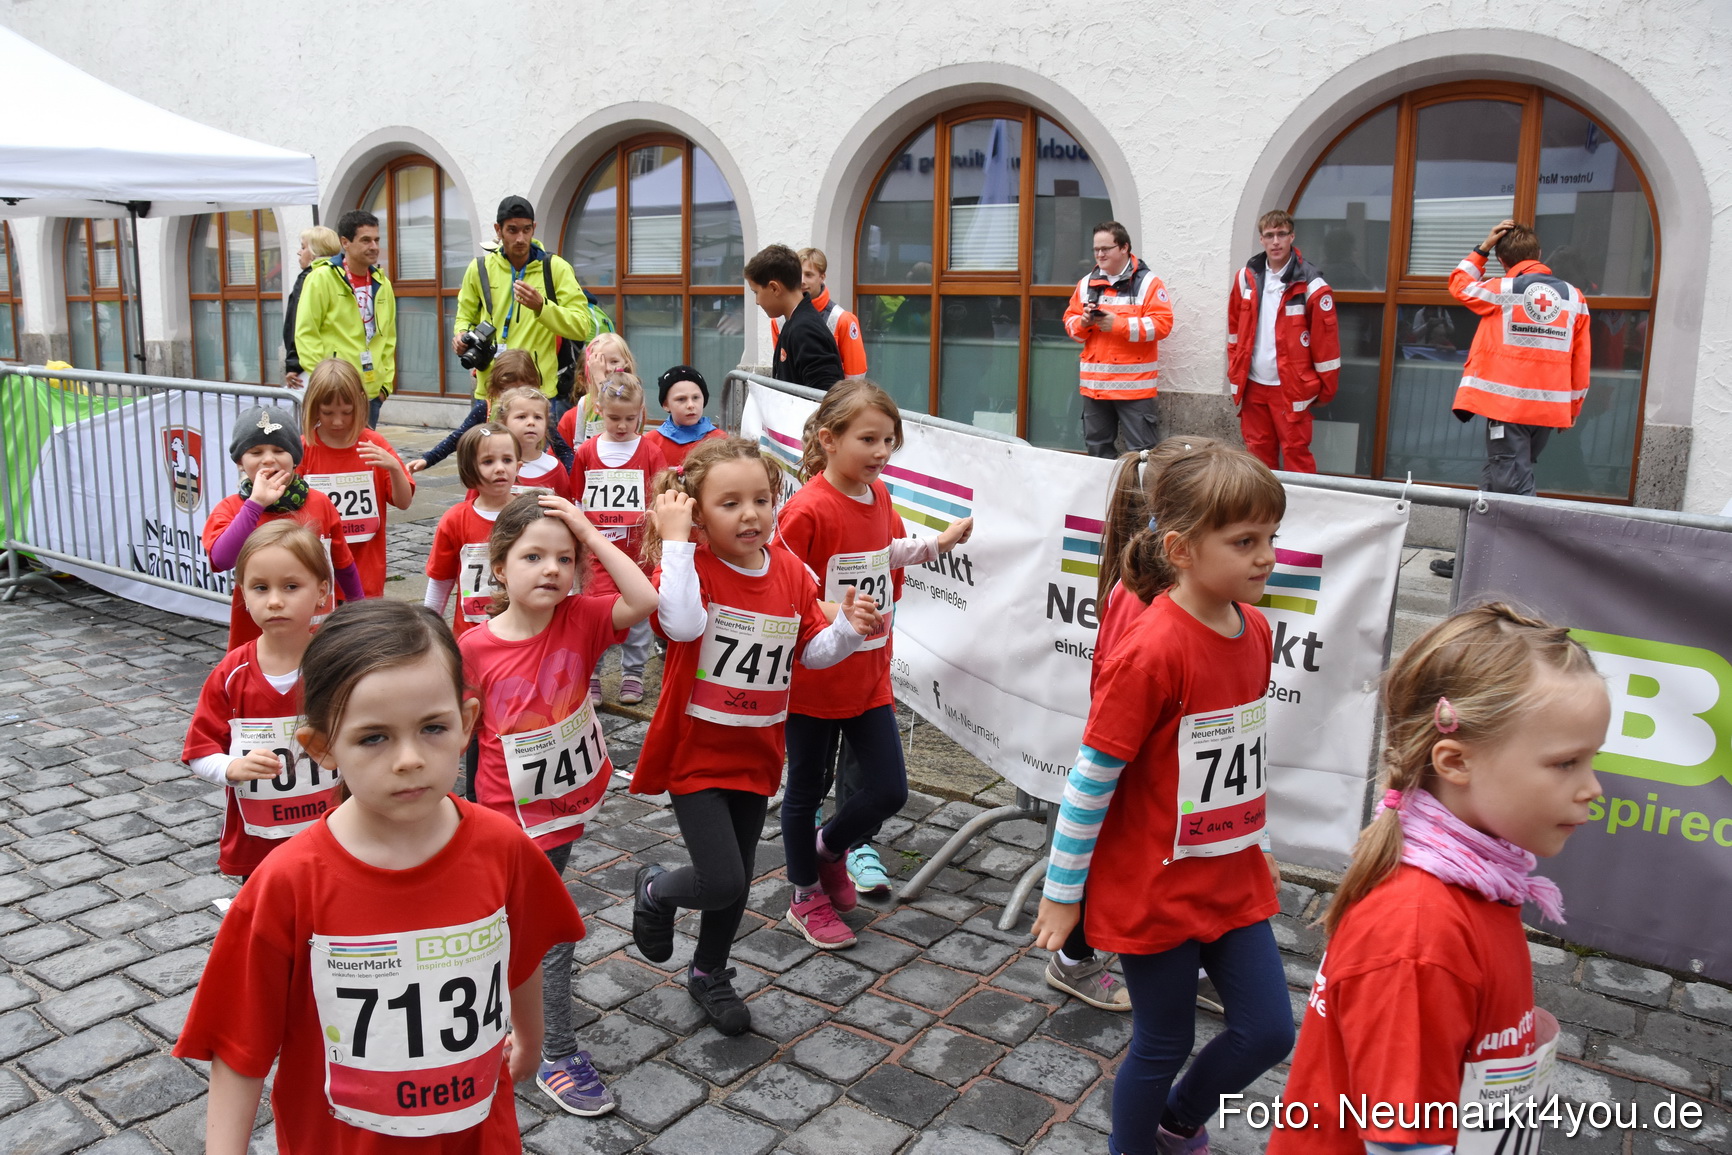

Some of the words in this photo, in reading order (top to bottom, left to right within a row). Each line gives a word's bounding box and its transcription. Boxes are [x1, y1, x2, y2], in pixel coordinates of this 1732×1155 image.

[1526, 301, 1541, 321] ROTES
[1543, 305, 1560, 321] KREUZ
[1511, 324, 1567, 338] Sanitätsdienst
[587, 484, 640, 508] 7124
[599, 513, 624, 524] Sarah
[930, 585, 968, 612] genießen
[714, 617, 756, 633] NeuerMarkt
[240, 732, 276, 740] NeuerMarkt
[944, 703, 1001, 749] NM-Neumarkt
[1191, 725, 1235, 740] NeuerMarkt
[514, 739, 556, 755] NeuerMarkt
[522, 722, 602, 796] 7411
[1195, 731, 1267, 804] 741
[271, 800, 328, 821] Emma
[550, 796, 590, 817] Nora
[1189, 816, 1233, 836] Laura
[415, 916, 503, 962] BOCK
[327, 957, 402, 971] NeuerMarkt
[416, 960, 452, 971] inspired
[453, 958, 464, 967] by
[465, 952, 486, 963] smart
[336, 959, 504, 1059] 7134
[396, 1075, 476, 1110] Greta
